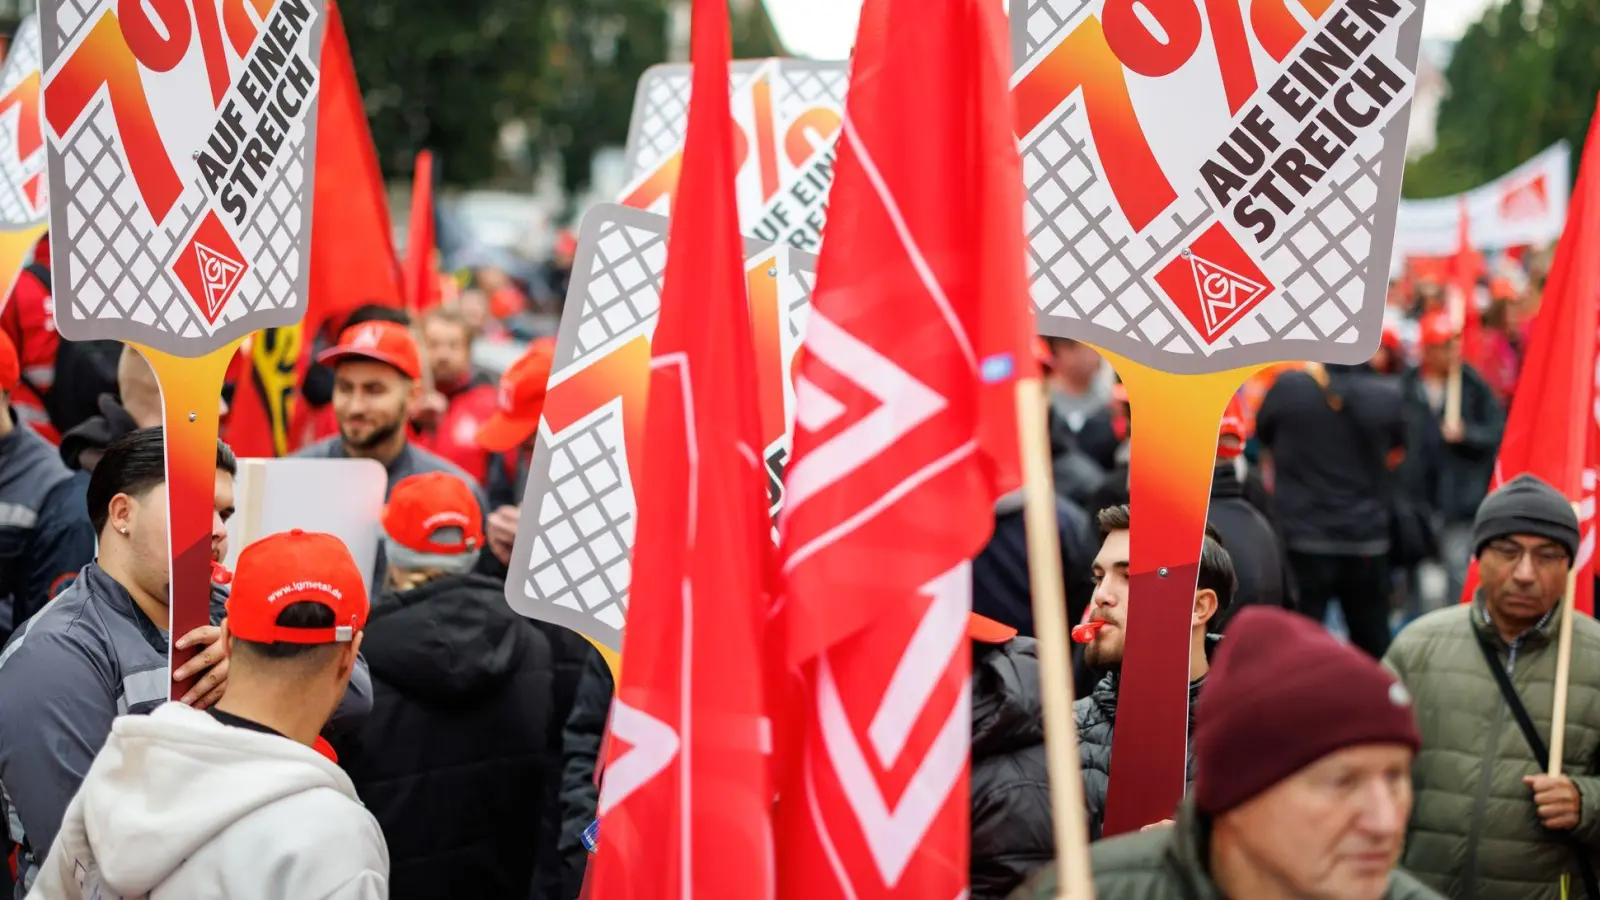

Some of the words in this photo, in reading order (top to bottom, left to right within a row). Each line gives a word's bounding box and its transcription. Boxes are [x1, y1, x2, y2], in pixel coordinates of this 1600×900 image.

[197, 98, 247, 195] AUF
[237, 0, 310, 115] EINEN
[221, 53, 315, 226] STREICH
[1199, 104, 1281, 208] AUF
[1267, 0, 1402, 123] EINEN
[1233, 53, 1406, 244] STREICH
